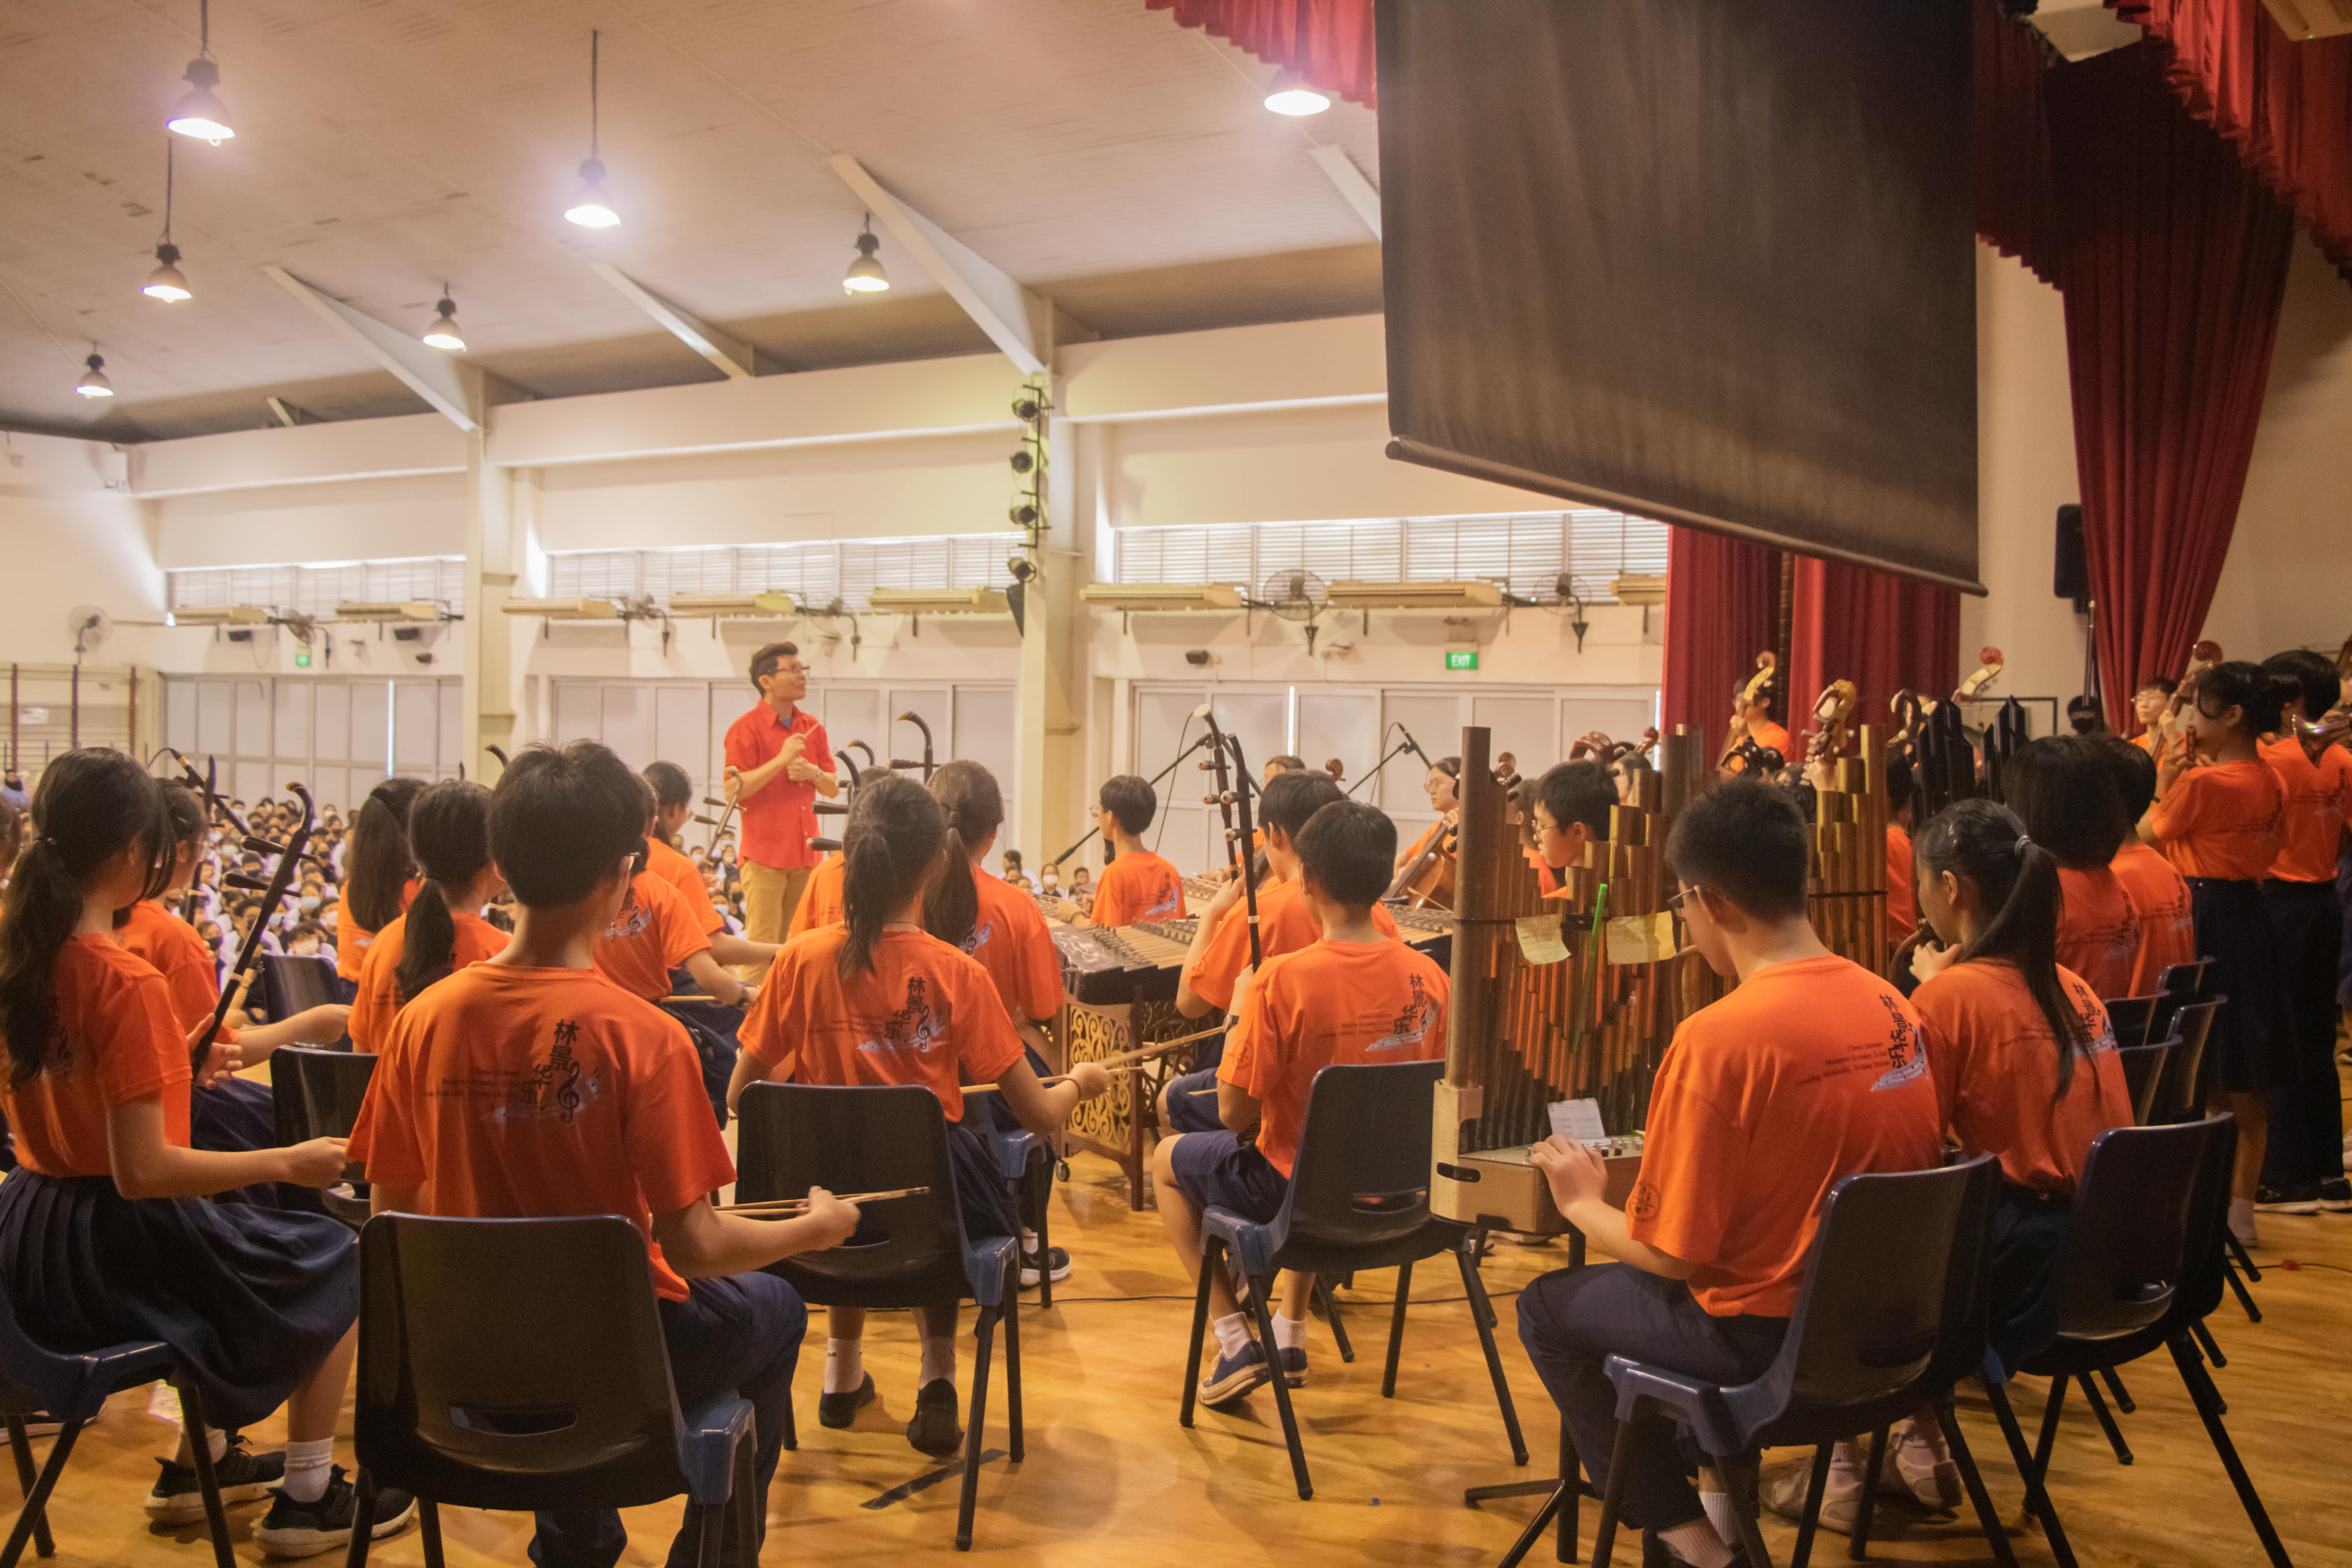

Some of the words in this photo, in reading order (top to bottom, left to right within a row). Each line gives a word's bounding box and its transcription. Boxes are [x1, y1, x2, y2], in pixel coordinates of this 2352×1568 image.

[1451, 655, 1471, 667] EXIT
[884, 976, 926, 1039] 林景华乐
[1393, 973, 1425, 1034] 林景华乐
[1879, 993, 1909, 1069] 林景华乐
[521, 1019, 580, 1105] 林景华乐
